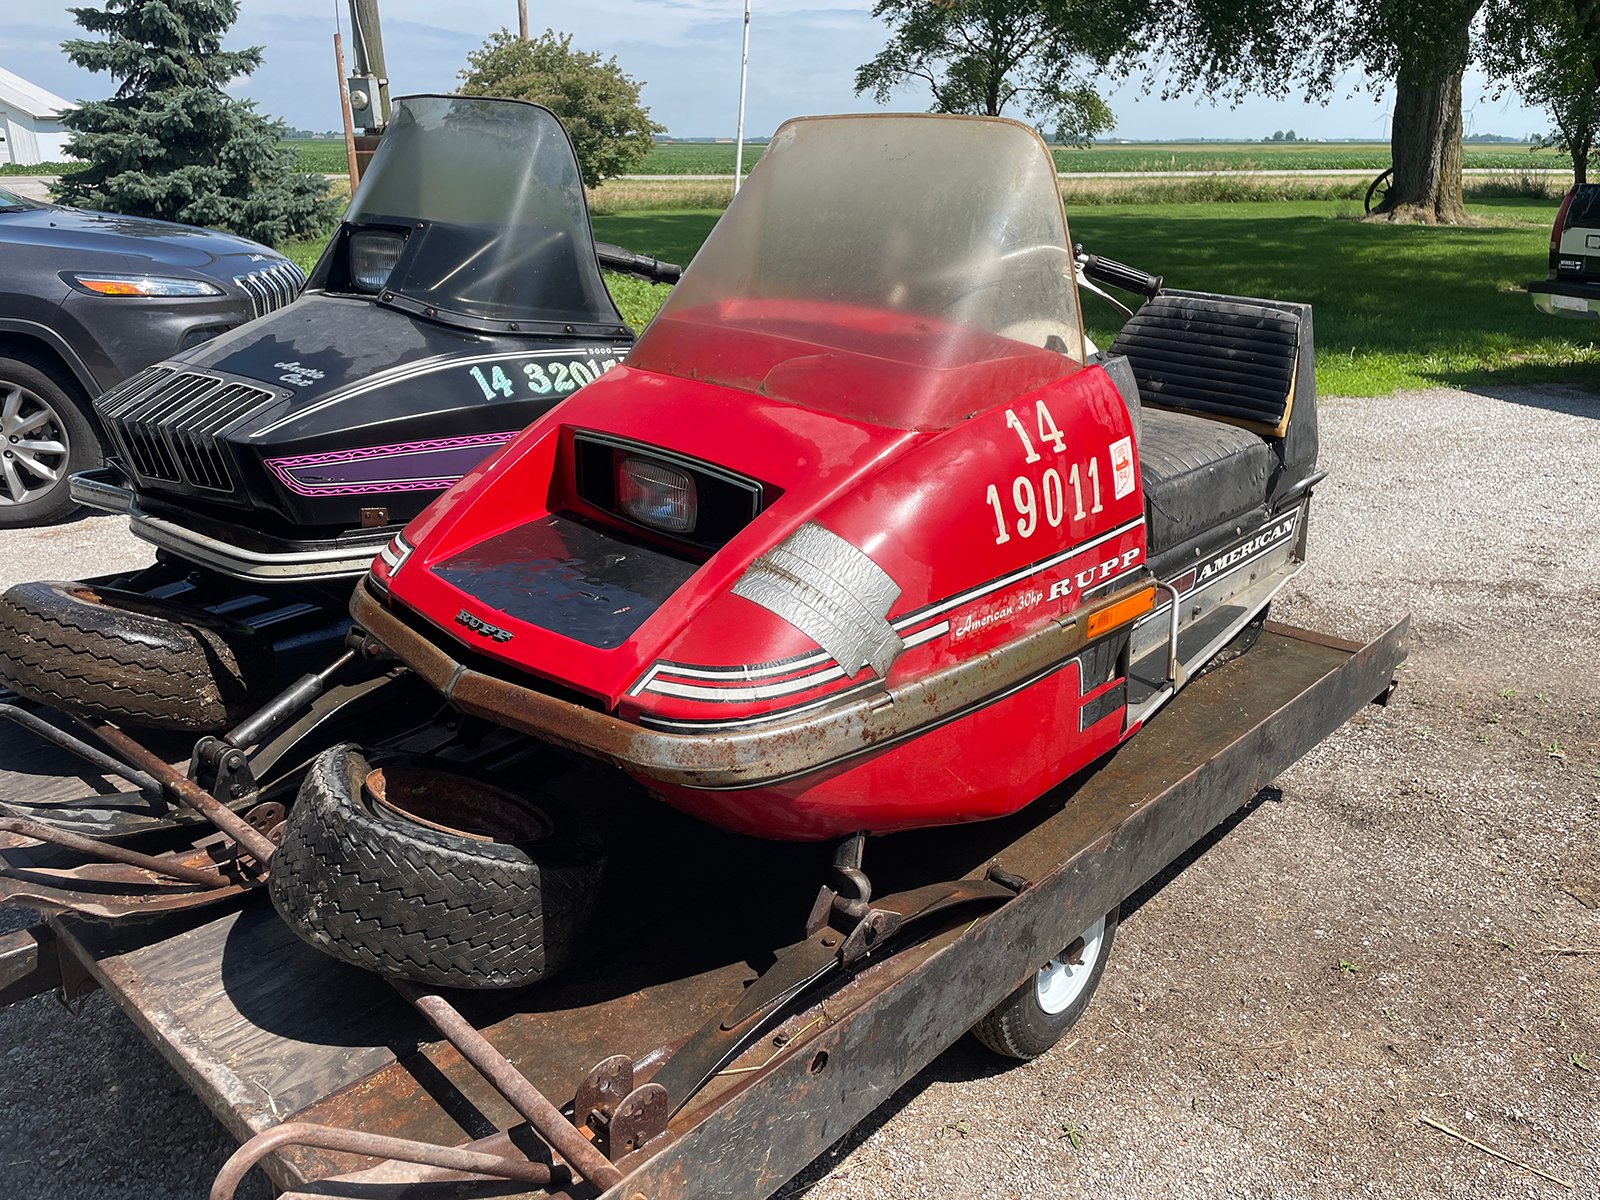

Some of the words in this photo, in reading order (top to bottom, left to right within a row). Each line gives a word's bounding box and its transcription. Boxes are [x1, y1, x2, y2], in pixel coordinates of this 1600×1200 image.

[470, 366, 514, 400] 14
[588, 347, 612, 355] 5000
[1005, 400, 1067, 464] 14
[986, 456, 1104, 544] 19011
[1196, 517, 1296, 583] AMERICAN
[956, 606, 1012, 637] American
[1018, 591, 1043, 610] 30hp
[1046, 547, 1141, 602] RUPP
[455, 608, 514, 643] RUPP
